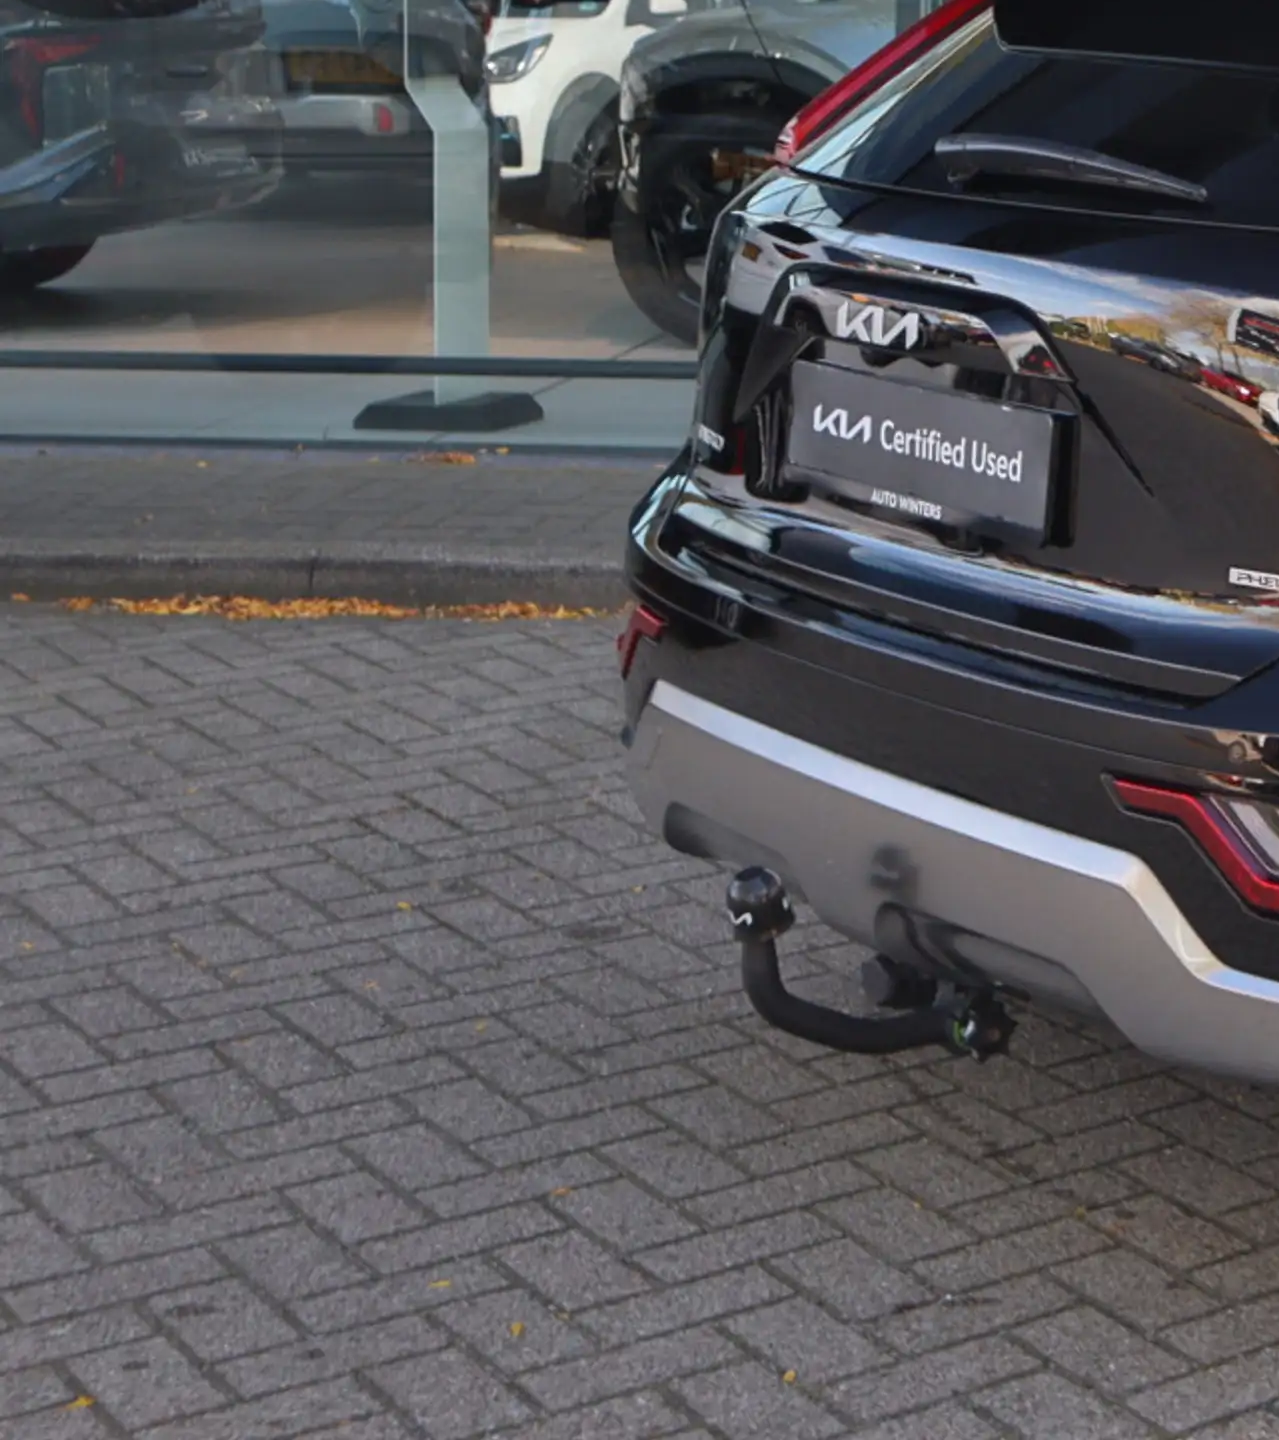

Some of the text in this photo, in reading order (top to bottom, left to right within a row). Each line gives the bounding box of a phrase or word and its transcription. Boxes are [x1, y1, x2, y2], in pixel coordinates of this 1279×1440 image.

[836, 301, 918, 350] KIA
[812, 403, 1023, 483] KIA Certified Used
[870, 488, 943, 521] AUTO WINTERS
